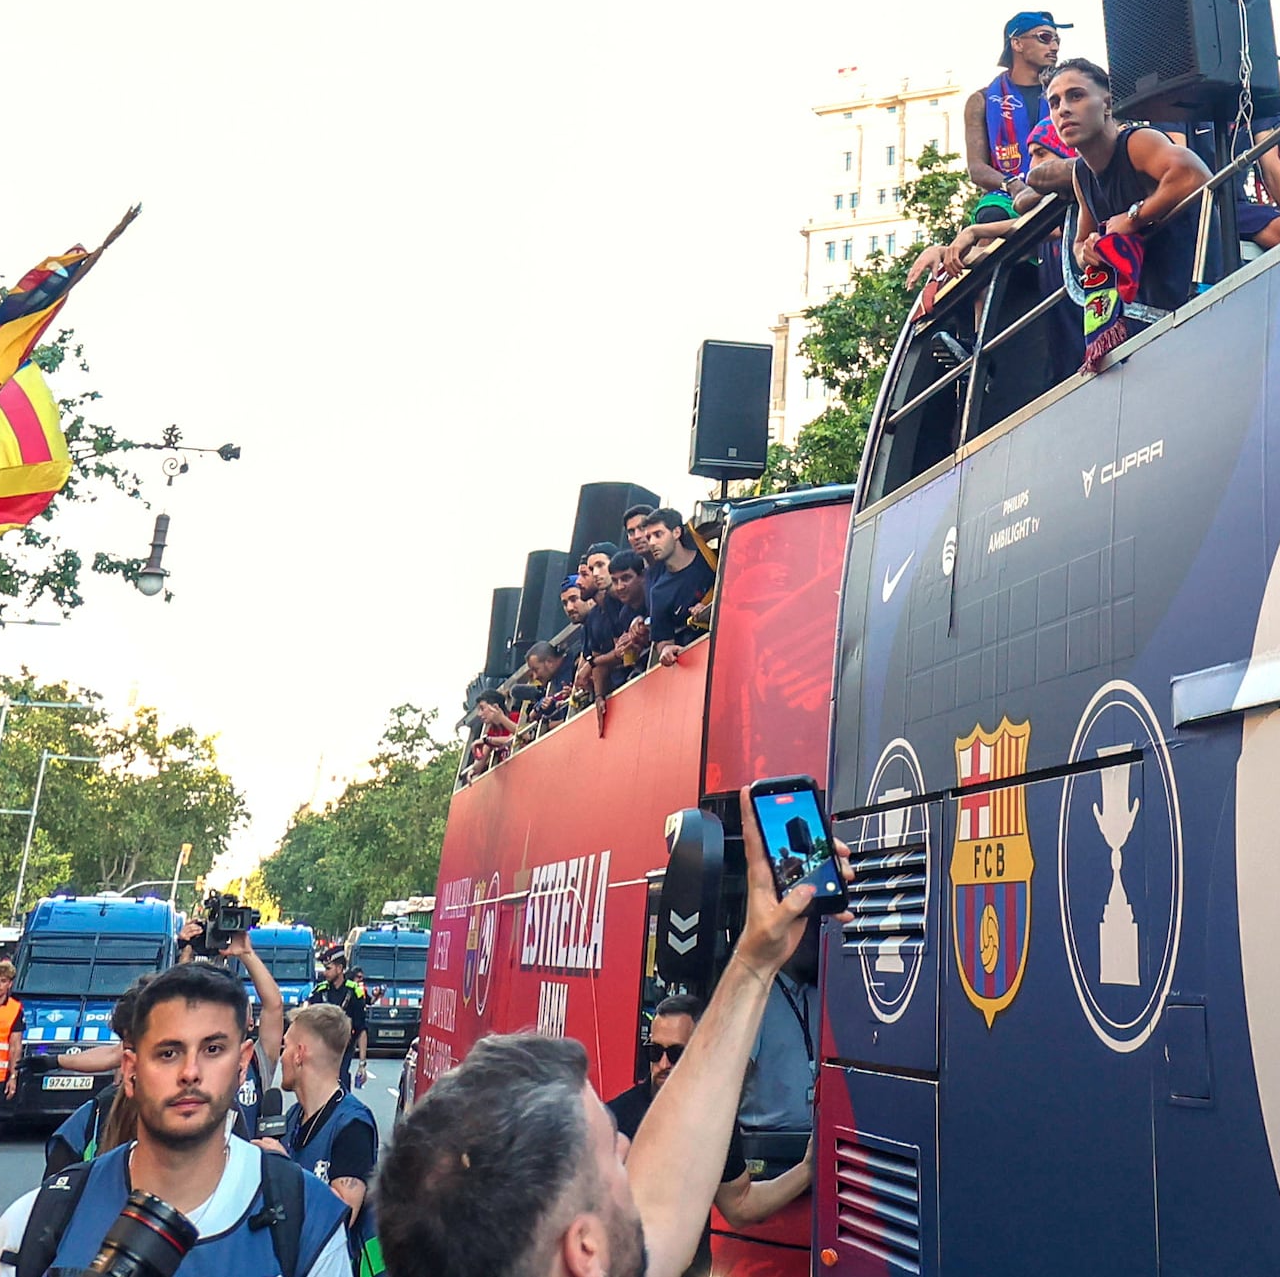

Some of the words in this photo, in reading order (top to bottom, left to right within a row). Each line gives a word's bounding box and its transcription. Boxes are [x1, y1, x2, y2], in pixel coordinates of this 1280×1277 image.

[1100, 439, 1163, 484] CUPRA
[1002, 489, 1029, 516] PHILIPS
[987, 517, 1030, 554] AMBILIGHT
[1031, 517, 1040, 534] tv
[974, 842, 1005, 879] FCB
[521, 850, 611, 970] ESTRELLA
[49, 1077, 72, 1086] 9747
